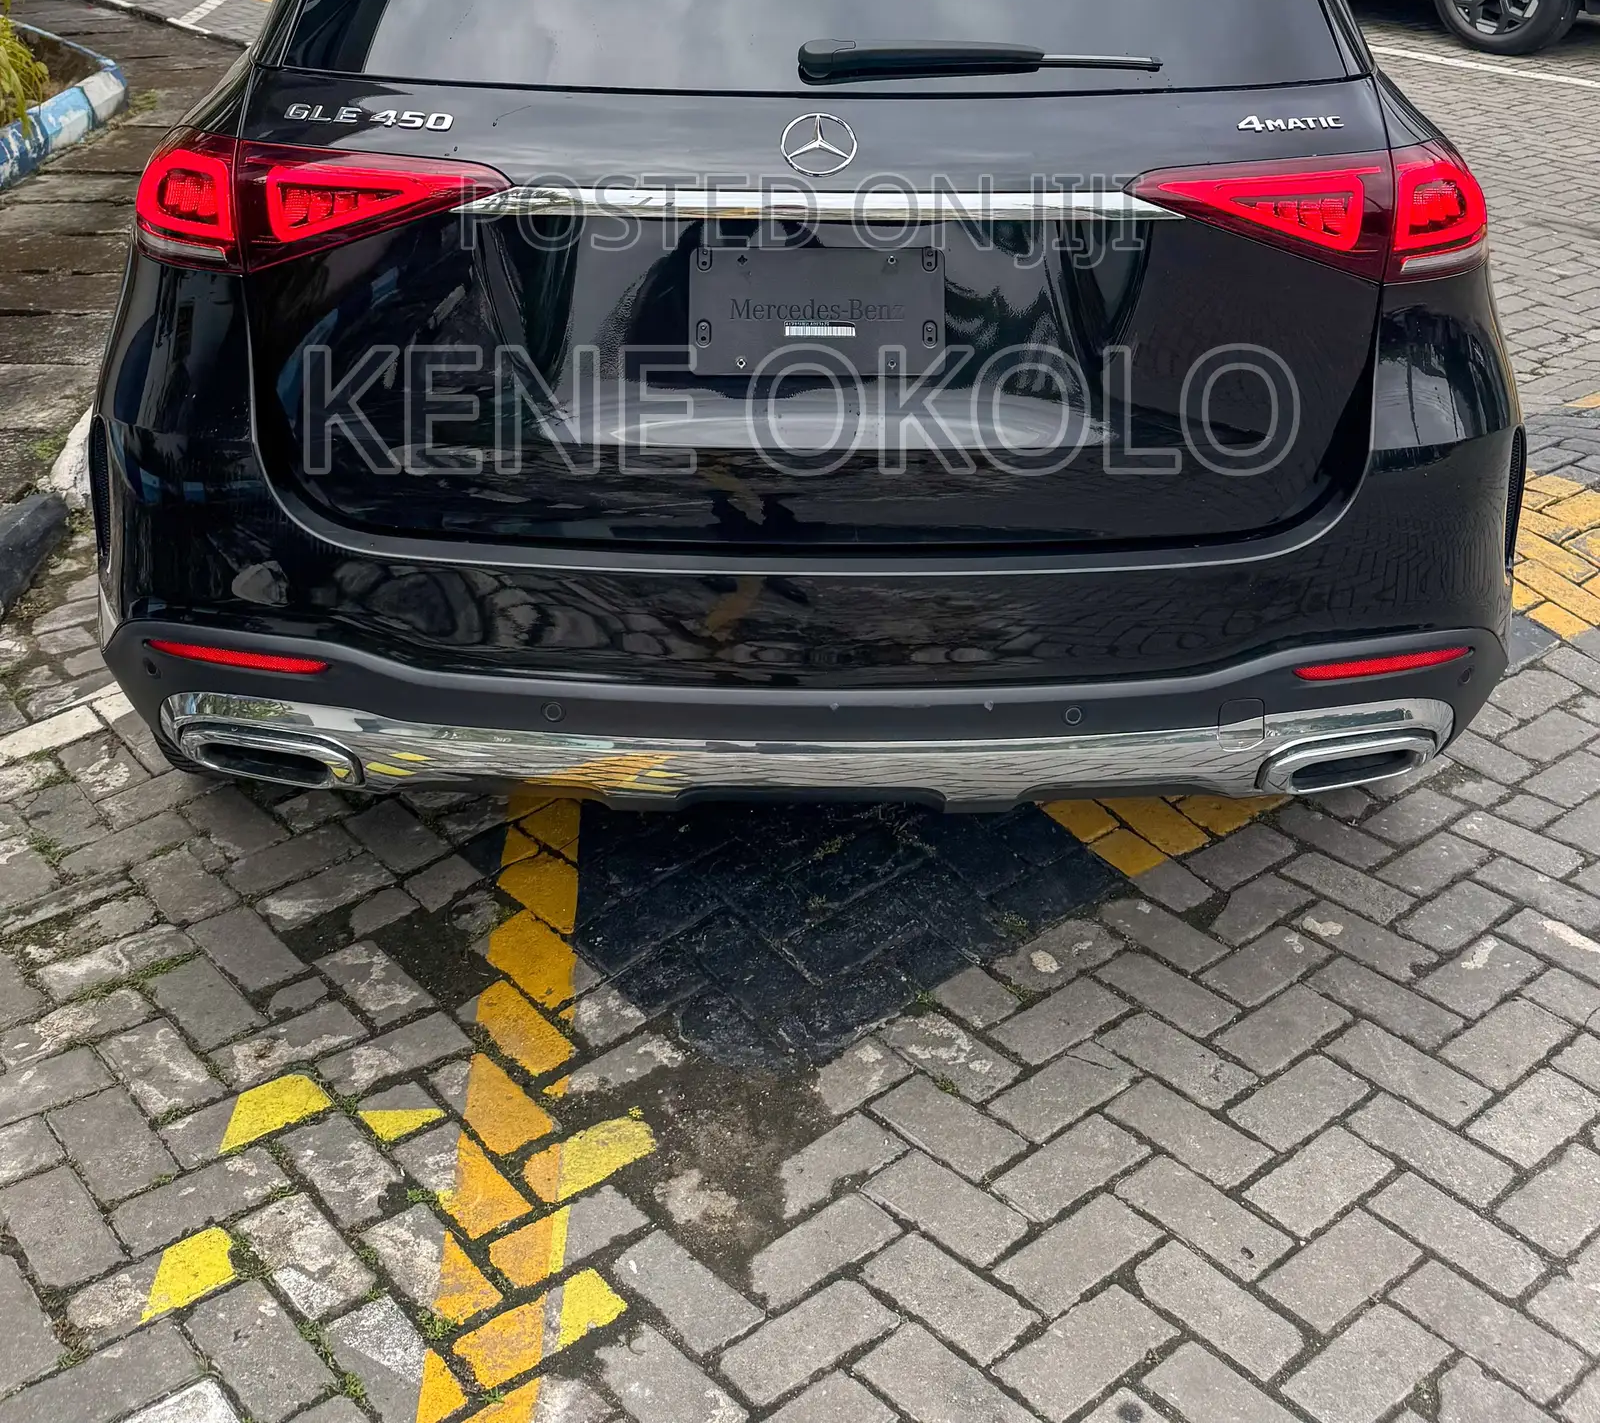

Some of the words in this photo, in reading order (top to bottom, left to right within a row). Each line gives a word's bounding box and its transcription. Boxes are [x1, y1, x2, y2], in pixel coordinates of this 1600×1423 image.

[284, 102, 363, 125] GLE
[369, 109, 454, 132] 450
[1237, 115, 1345, 133] 4MATIC
[729, 298, 905, 321] Mercedes-Benz
